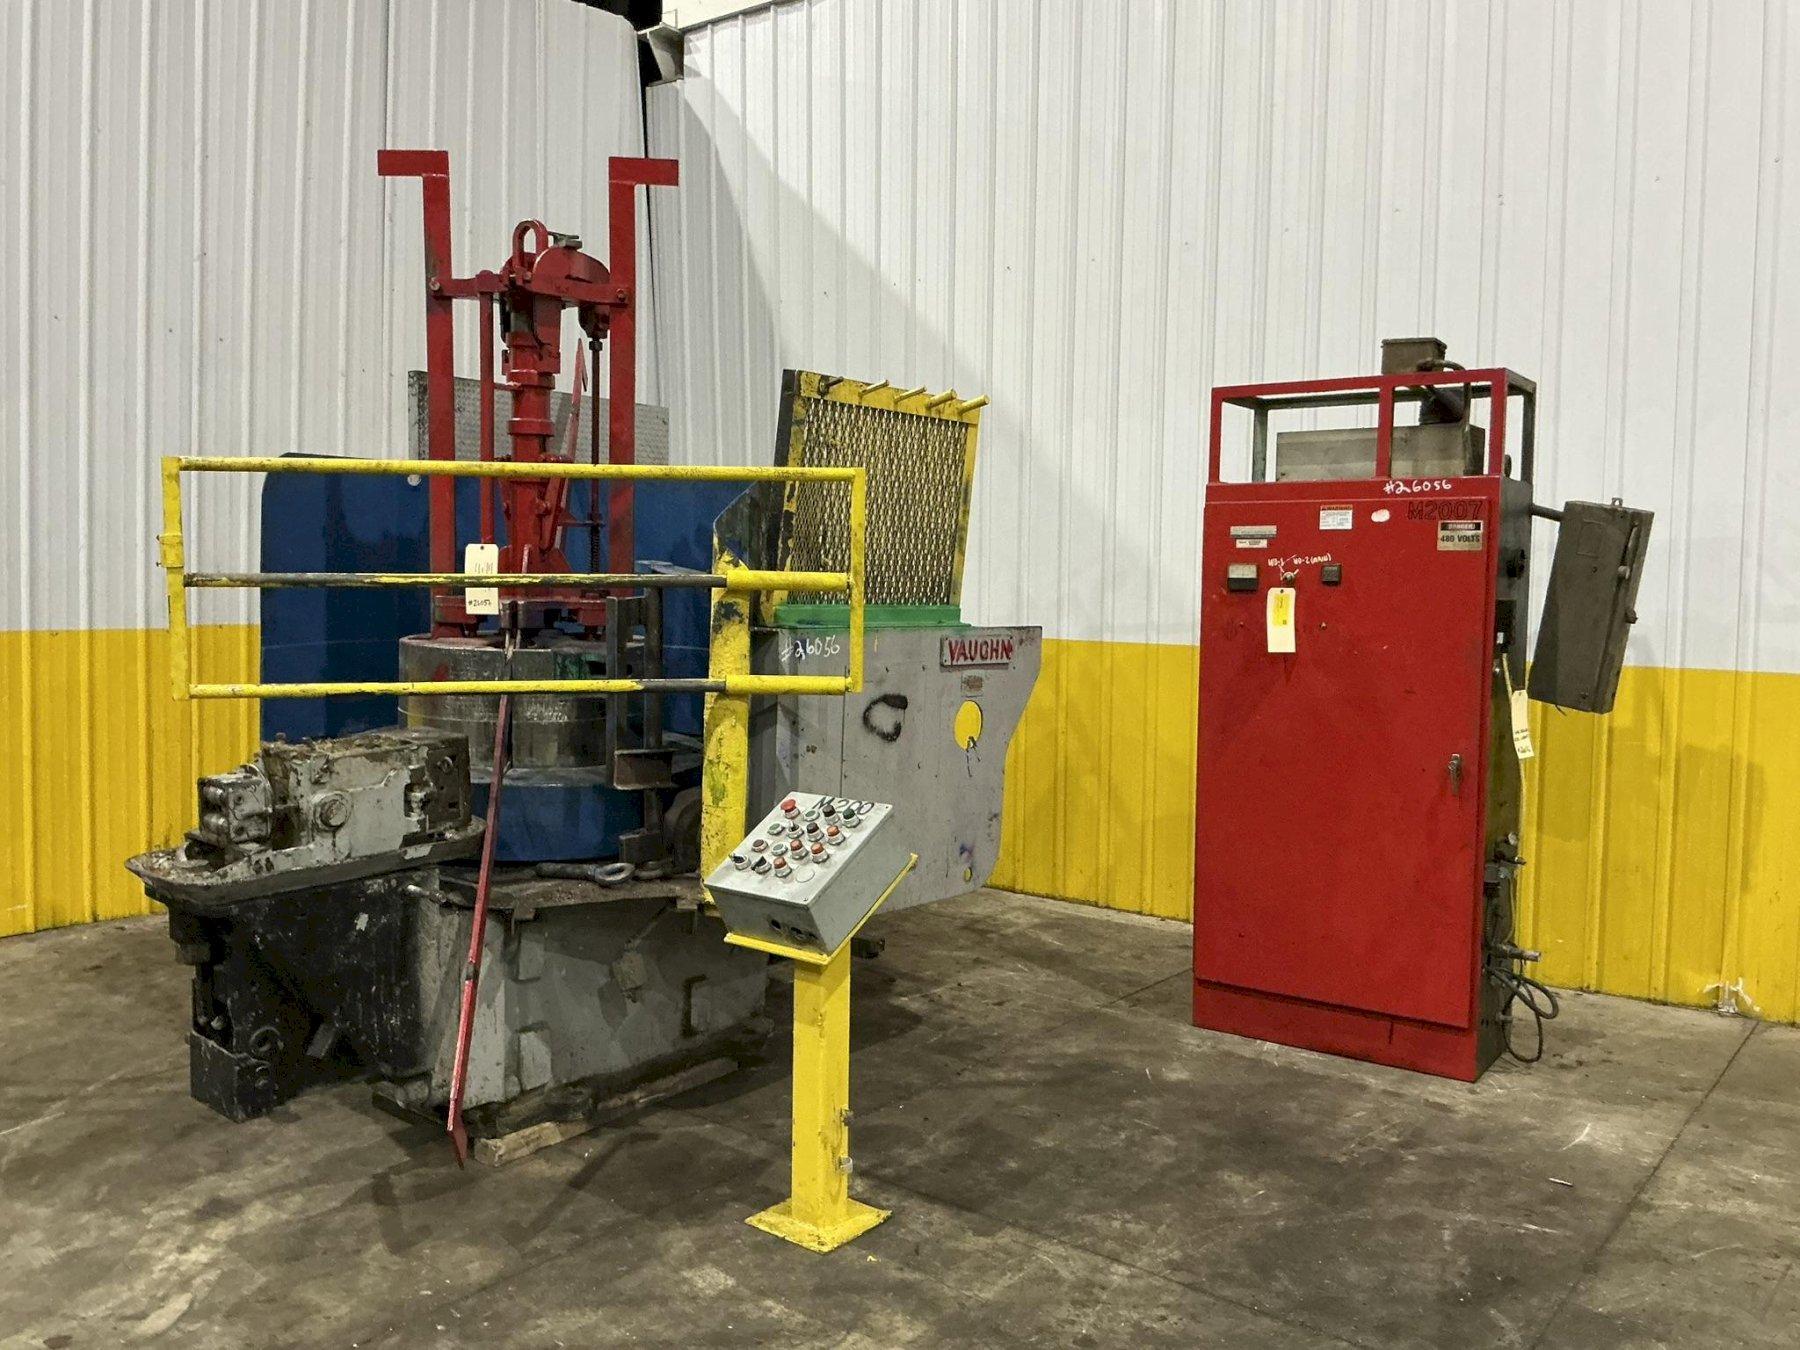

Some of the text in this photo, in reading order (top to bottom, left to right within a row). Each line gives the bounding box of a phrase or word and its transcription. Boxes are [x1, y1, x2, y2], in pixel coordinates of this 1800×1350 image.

[1382, 479, 1453, 495] #26056
[1406, 500, 1483, 521] M2007
[1440, 534, 1480, 543] 480 VOLTS
[781, 634, 841, 662] #26056
[948, 638, 1013, 664] VAUGHN
